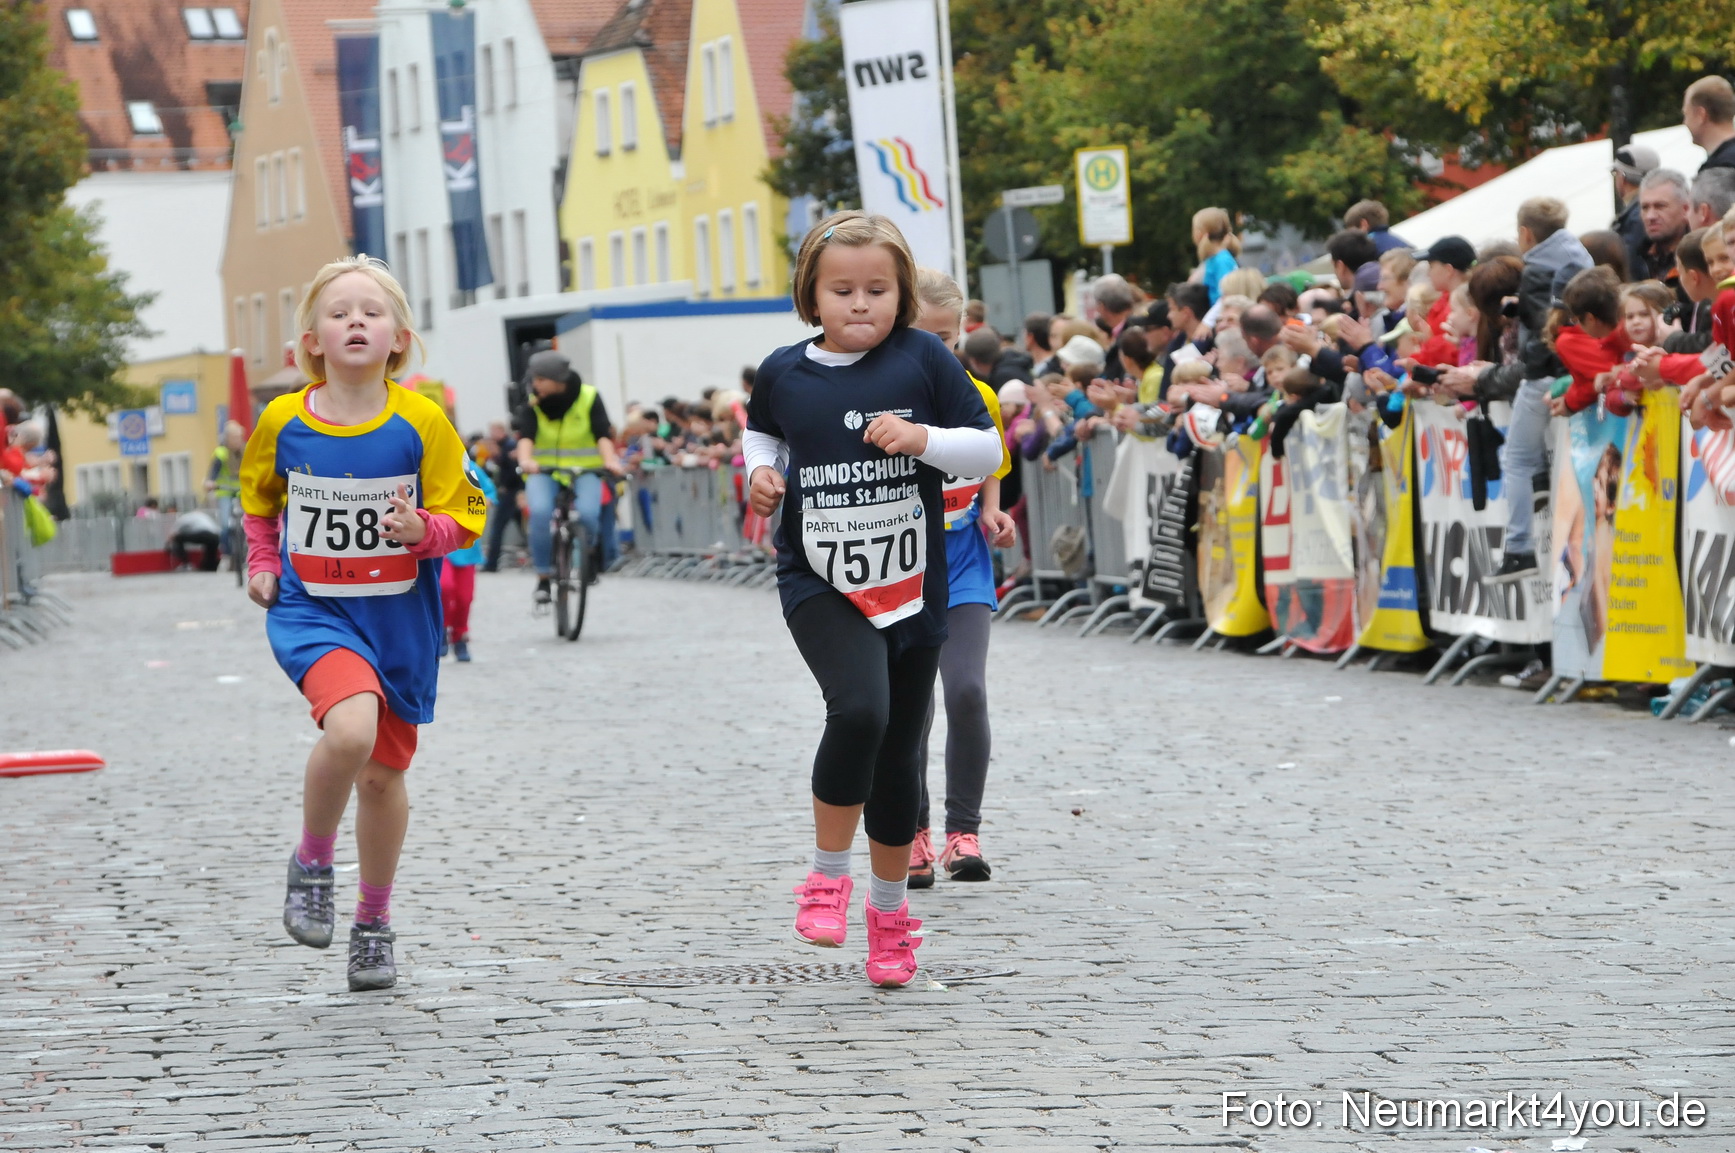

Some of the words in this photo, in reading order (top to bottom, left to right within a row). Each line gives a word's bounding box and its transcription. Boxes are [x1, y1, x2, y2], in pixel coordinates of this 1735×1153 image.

[800, 455, 917, 488] GRUNDSCHULE
[291, 484, 329, 500] PARTL
[332, 489, 396, 502] Neumarkt
[467, 496, 485, 506] PA
[802, 493, 814, 509] im
[817, 490, 850, 508] Haus
[467, 507, 485, 515] Neu
[806, 521, 844, 533] PARTL
[848, 513, 909, 532] Neumarkt
[817, 527, 918, 585] 7570
[324, 559, 355, 579] Ida
[894, 919, 911, 927] LICO
